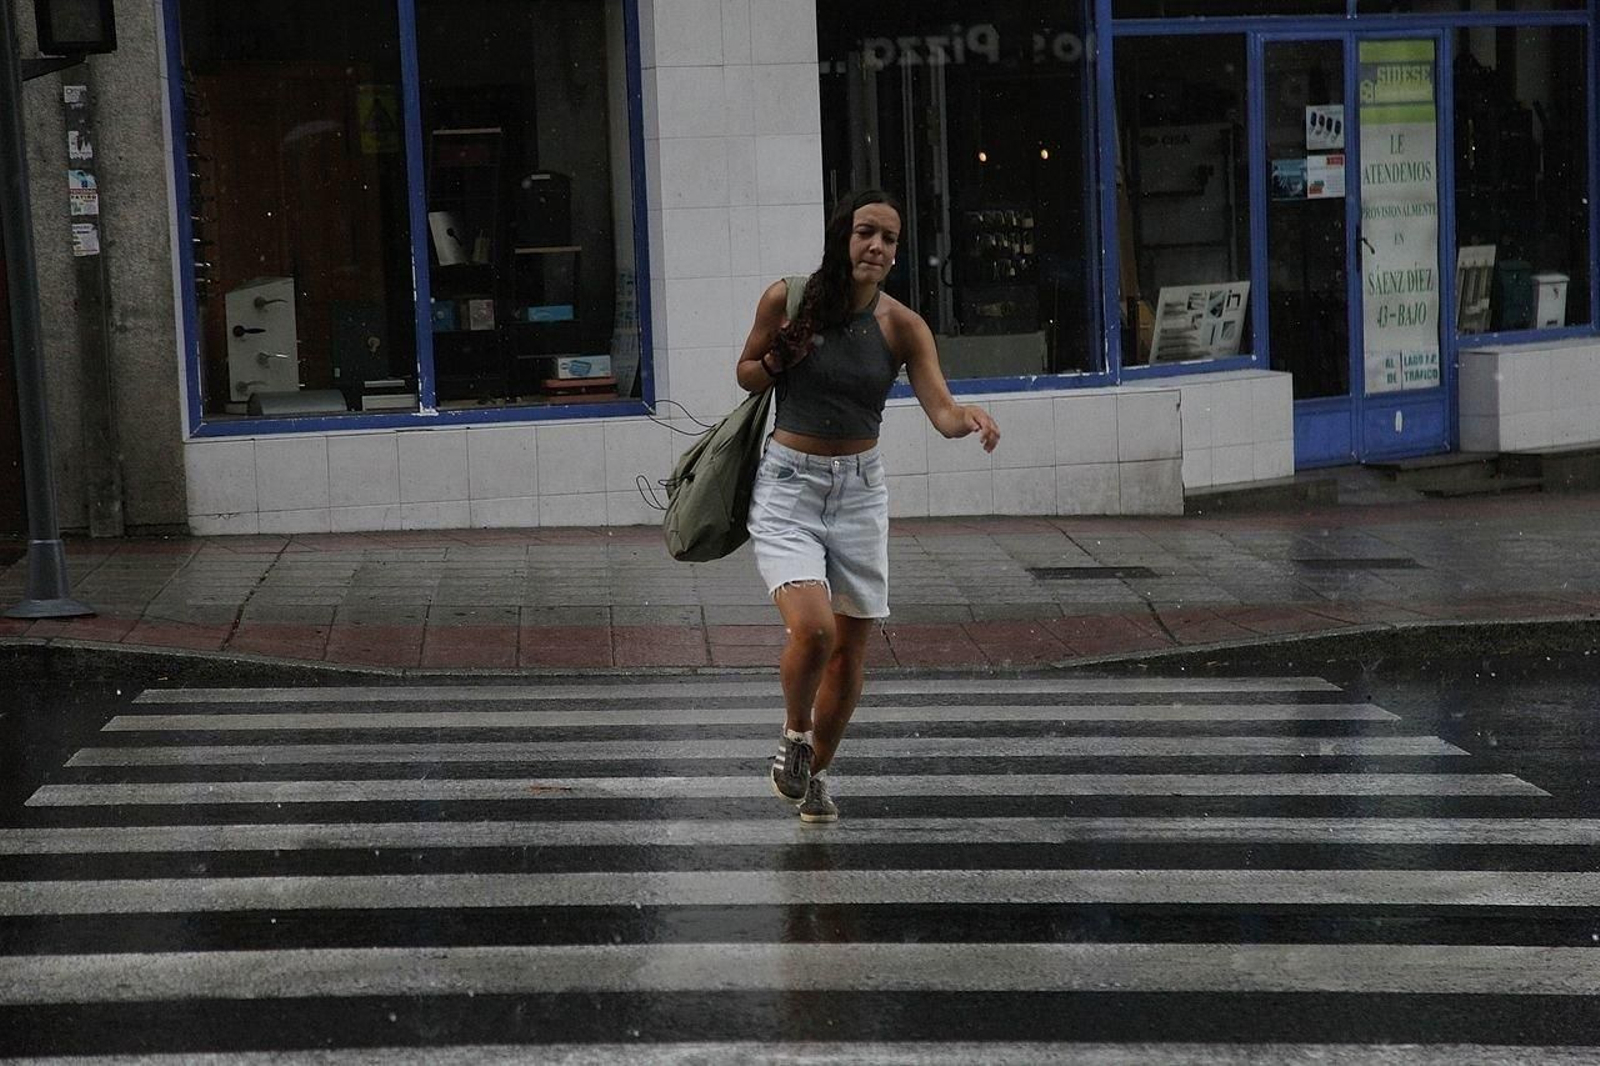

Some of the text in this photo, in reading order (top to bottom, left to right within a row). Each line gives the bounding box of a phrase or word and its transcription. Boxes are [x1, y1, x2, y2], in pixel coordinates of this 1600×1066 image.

[1390, 134, 1404, 155] LE
[1363, 161, 1431, 184] ATENDEMOS
[1361, 204, 1436, 219] PROVISIONALMENTE
